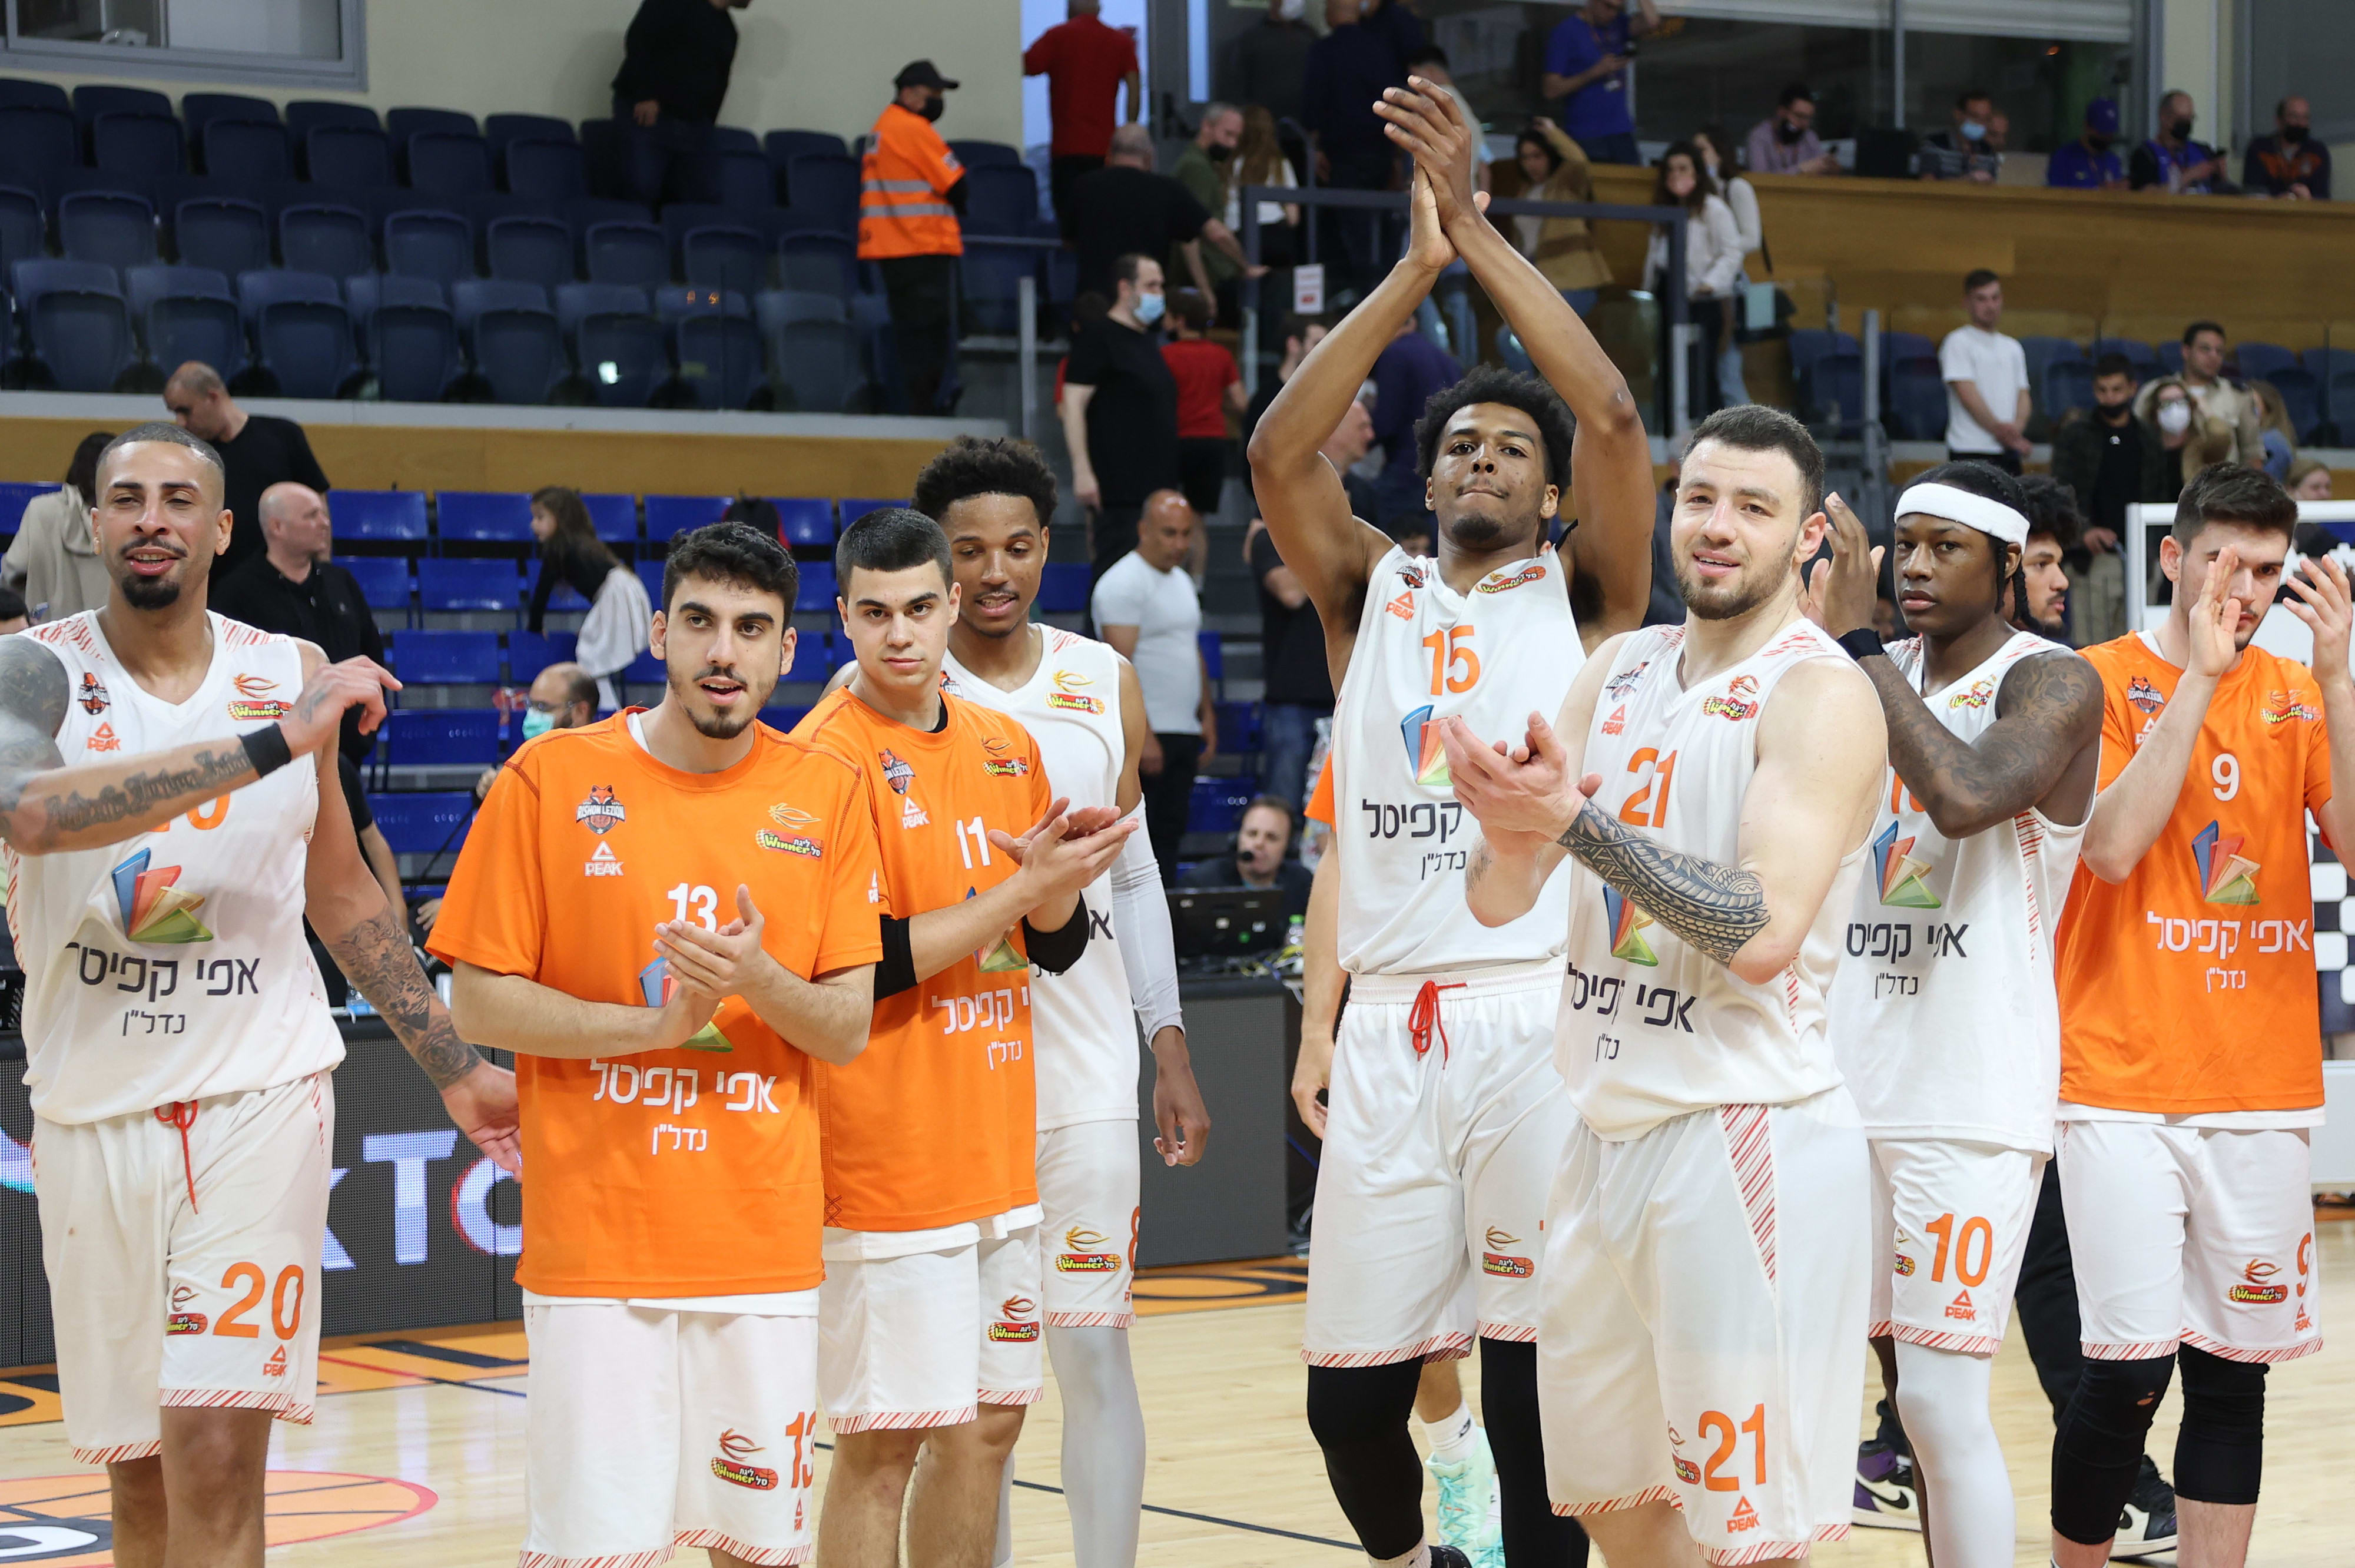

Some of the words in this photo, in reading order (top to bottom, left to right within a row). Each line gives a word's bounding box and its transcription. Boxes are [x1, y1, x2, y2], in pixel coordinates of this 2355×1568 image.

[1423, 625, 1481, 695] 15
[235, 705, 280, 717] Winner
[1051, 696, 1090, 710] Winner
[1601, 721, 1626, 735] PEAK
[87, 737, 121, 752] PEAK
[1618, 747, 1677, 828] 21
[2211, 753, 2240, 801] 9
[902, 811, 930, 830] PEAK
[1362, 798, 1462, 843] קפיטל
[764, 834, 811, 854] Winner
[811, 846, 821, 857] סל
[794, 838, 811, 847] ליגת
[955, 816, 991, 870] 11
[584, 861, 624, 877] PEAK
[1421, 851, 1466, 880] נדל"ן
[667, 882, 718, 933] 13
[2147, 910, 2241, 960] קפיטל
[2250, 919, 2310, 953] אפי
[196, 957, 261, 996] אפי
[2206, 967, 2247, 993] נדל"ן
[931, 987, 1014, 1036] קפיטל
[1636, 983, 1697, 1033] אפי
[122, 1009, 185, 1036] נדל"ן
[987, 1040, 1023, 1071] נדל"ן
[590, 1058, 698, 1115] קפיטל
[715, 1071, 780, 1113] אפי
[652, 1123, 708, 1156] נדל"ן
[1061, 1258, 1104, 1269] Winner
[1087, 1255, 1103, 1264] ליגת
[1498, 1258, 1514, 1267] ליגת
[1925, 1213, 1992, 1288] 10
[1514, 1264, 1525, 1274] סל
[213, 1261, 304, 1340] 20
[2237, 1288, 2276, 1301] Winner
[1945, 1305, 1978, 1321] PEAK
[995, 1326, 1032, 1338] Winner
[1698, 1403, 1767, 1492] 21
[717, 1463, 755, 1484] Winner
[755, 1474, 768, 1487] סל
[1726, 1513, 1760, 1533] PEAK
